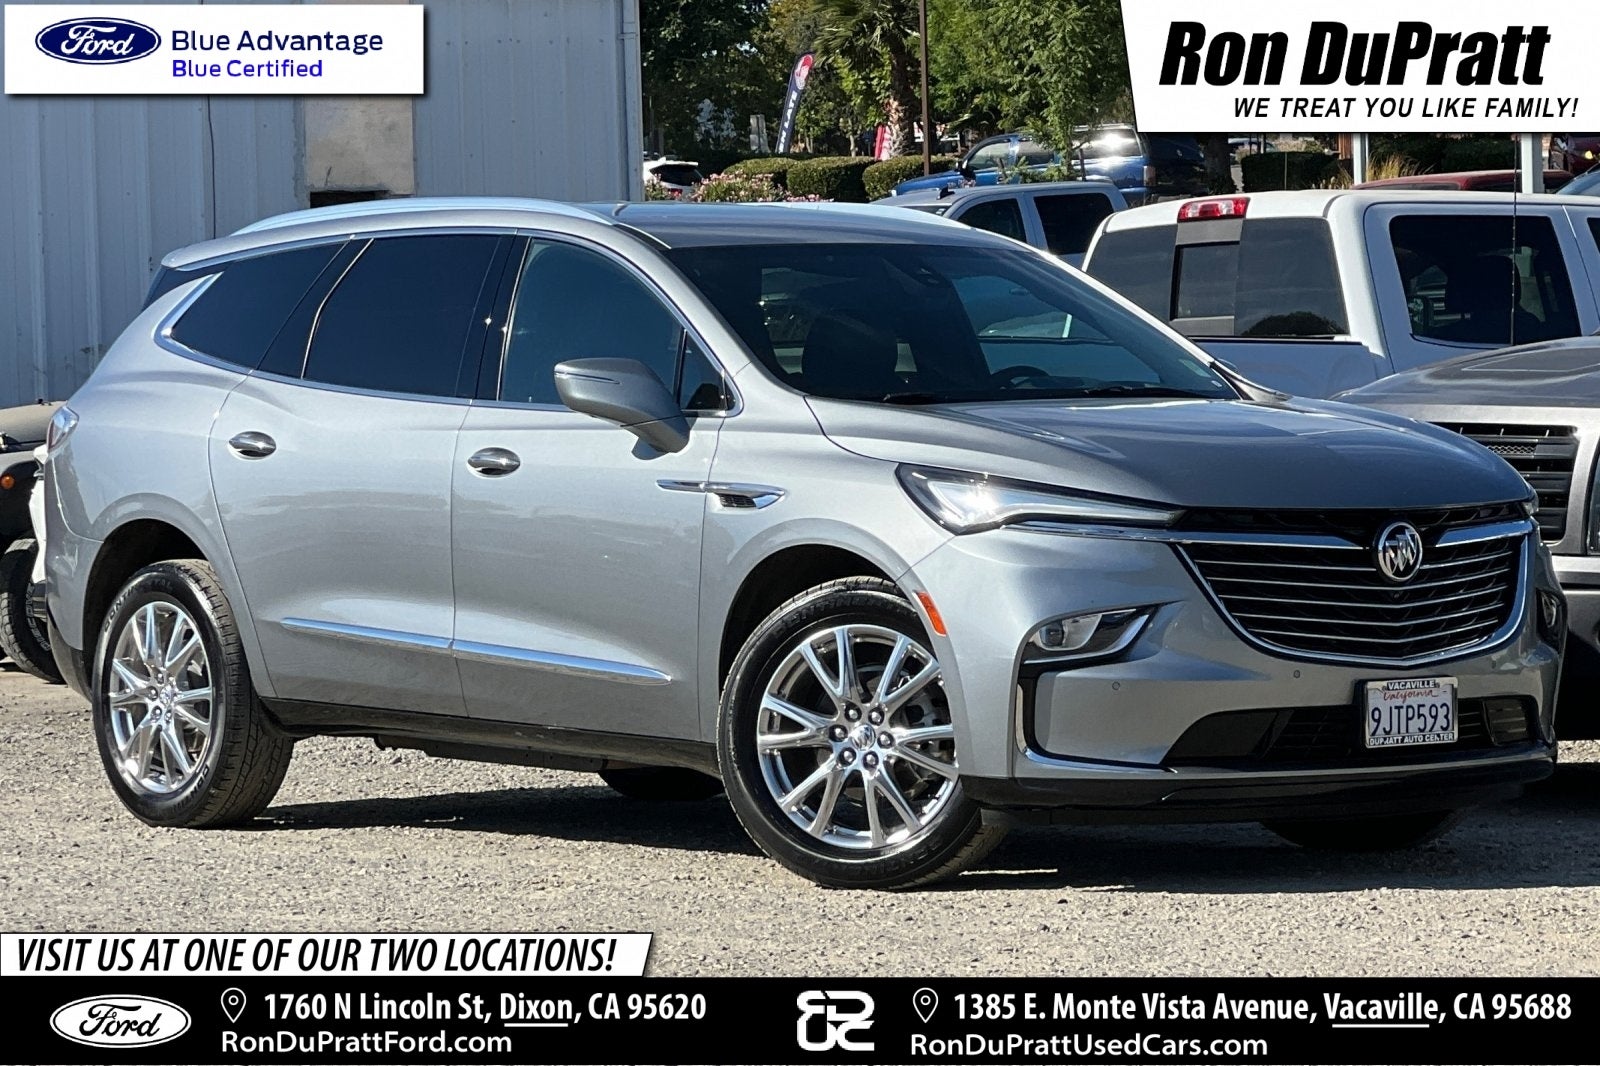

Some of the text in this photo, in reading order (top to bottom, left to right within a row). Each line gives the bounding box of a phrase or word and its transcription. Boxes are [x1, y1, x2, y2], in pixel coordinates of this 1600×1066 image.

[1387, 680, 1435, 690] VACAVILLE
[1383, 689, 1440, 704] California
[1370, 702, 1450, 736] 9JTP593
[1403, 734, 1424, 743] AUTO
[1424, 732, 1454, 742] CENTER
